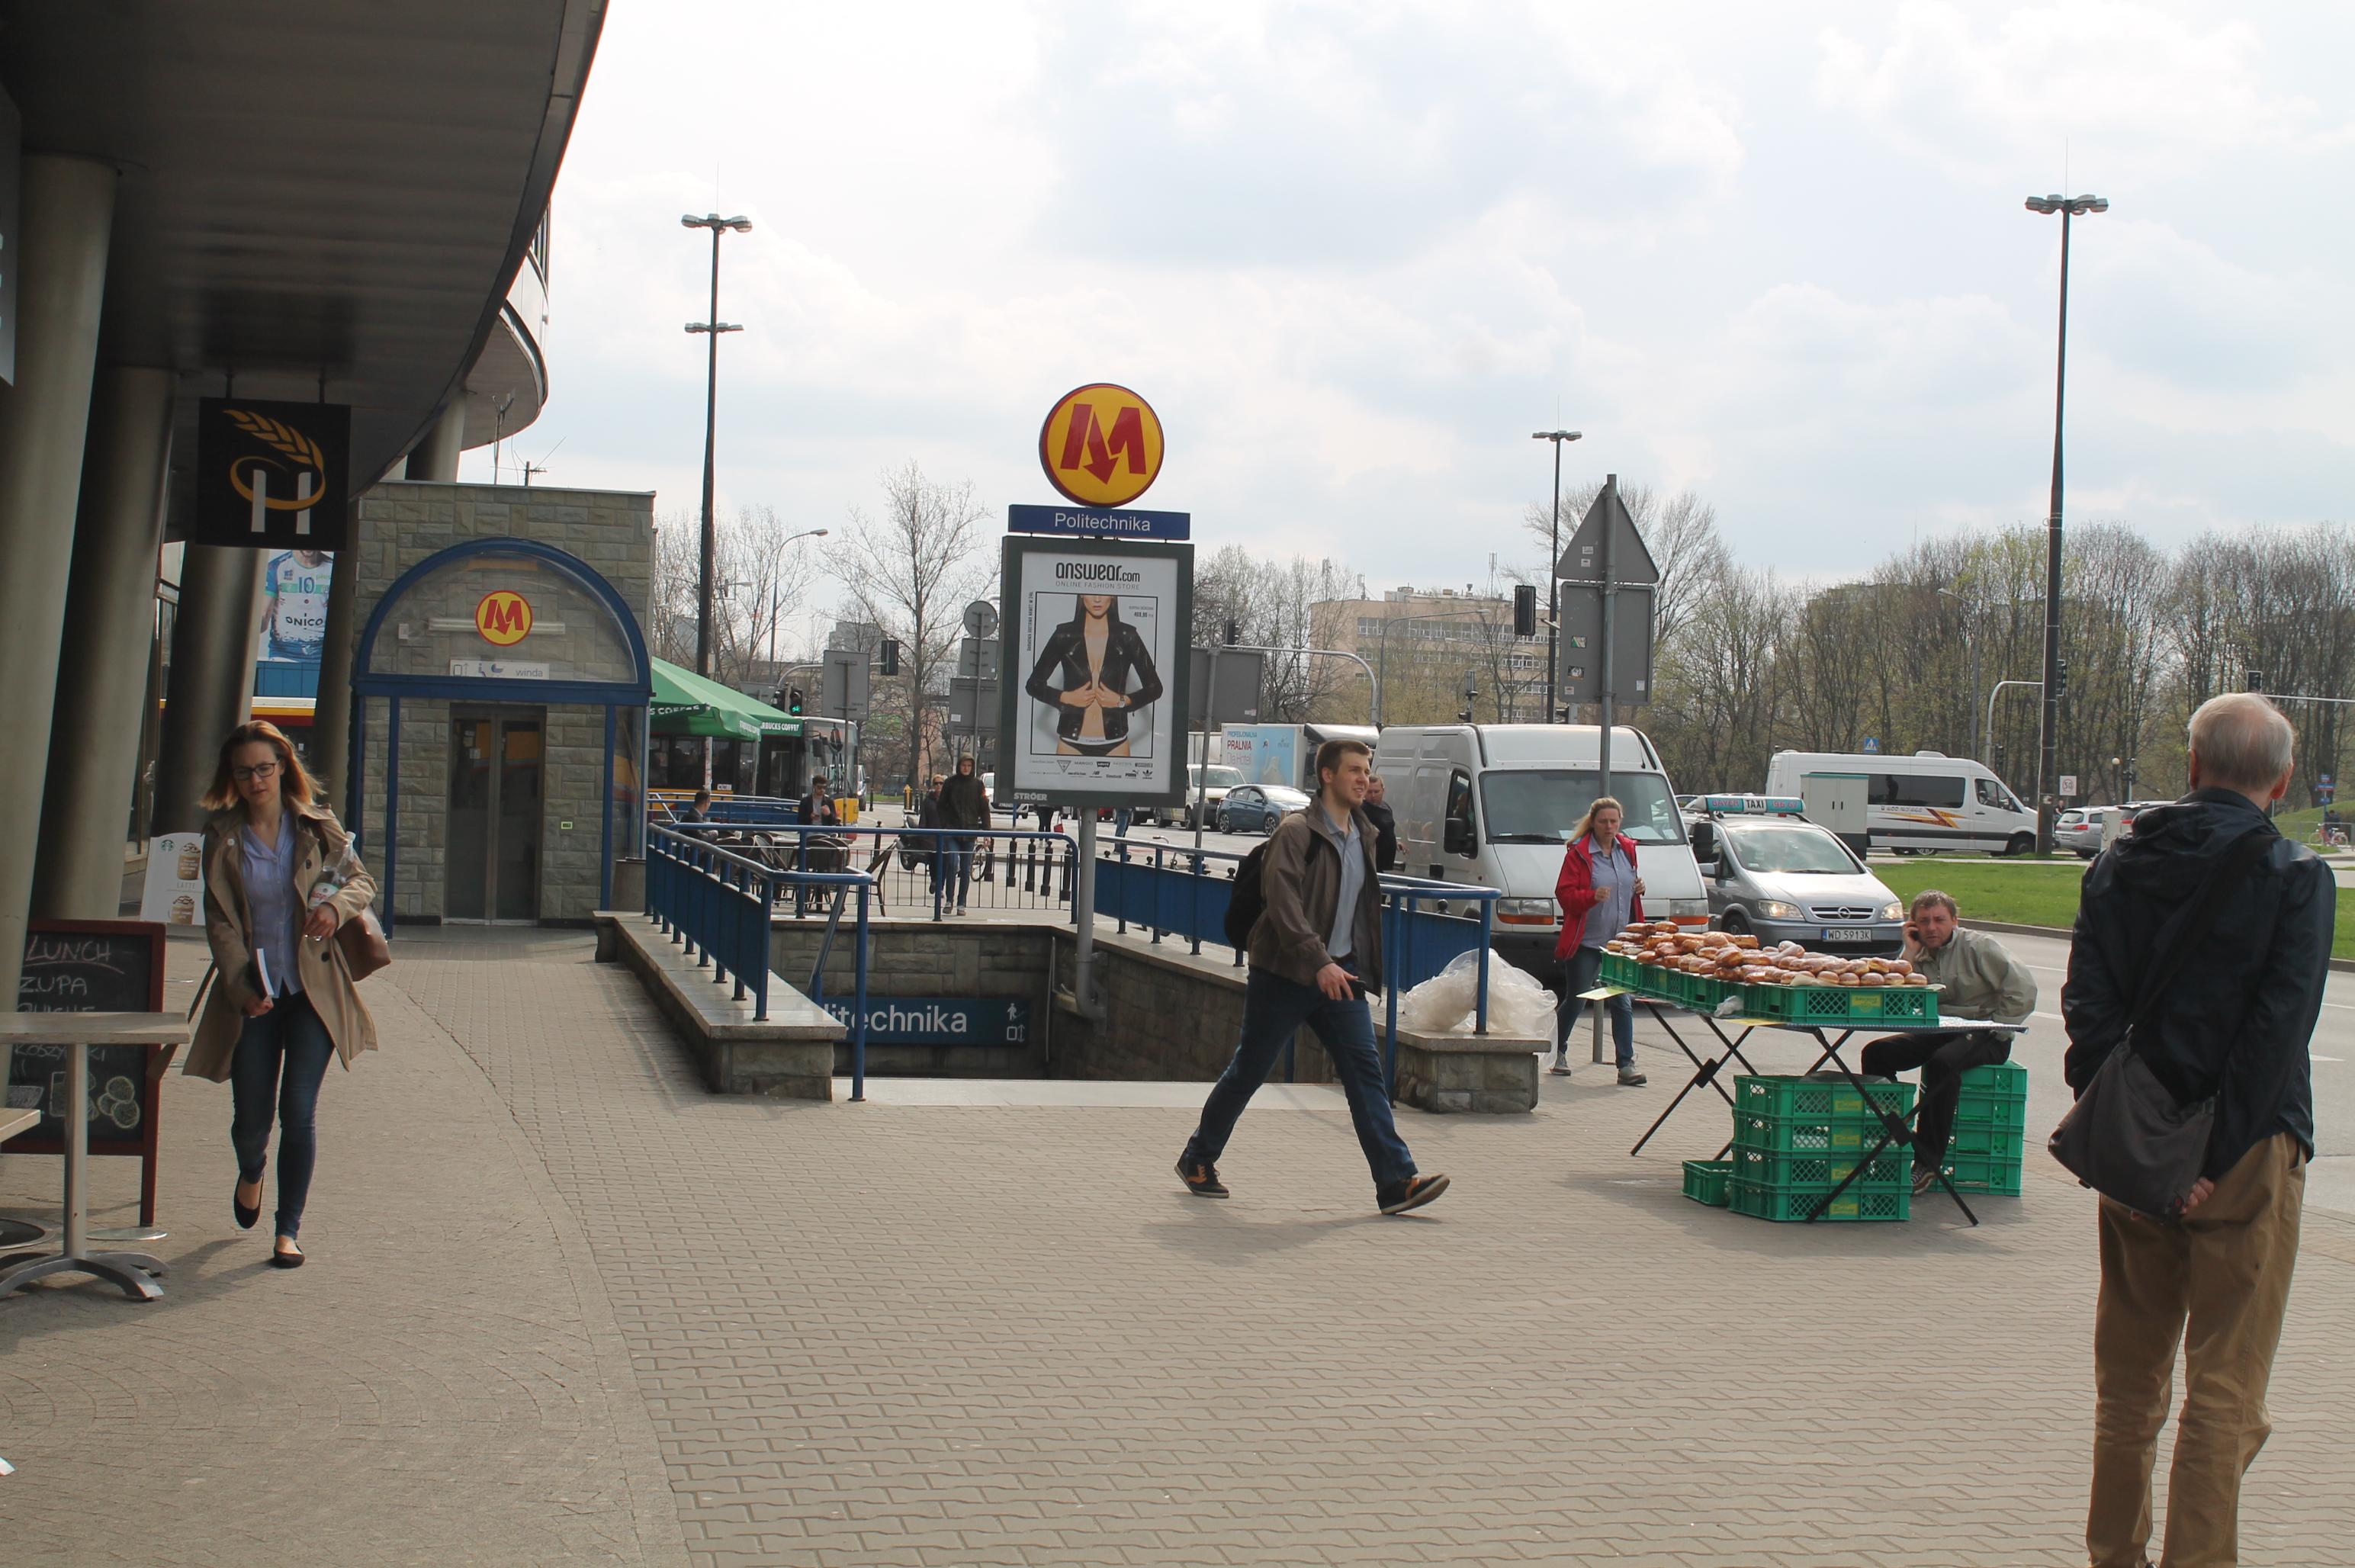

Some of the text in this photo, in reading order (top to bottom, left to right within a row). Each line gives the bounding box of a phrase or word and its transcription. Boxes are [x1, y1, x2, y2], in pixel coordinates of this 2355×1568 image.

[1055, 512, 1151, 532] Politechnika
[1055, 562, 1140, 582] answear.com
[298, 577, 315, 593] 10
[516, 668, 543, 678] winda
[1227, 740, 1251, 750] PRALNIA
[1014, 792, 1047, 802] STRÖER
[1746, 799, 1764, 808] TAXI
[1828, 930, 1870, 940] WD 5913K
[25, 934, 112, 962] LUNCH
[20, 975, 88, 996] ZUPA
